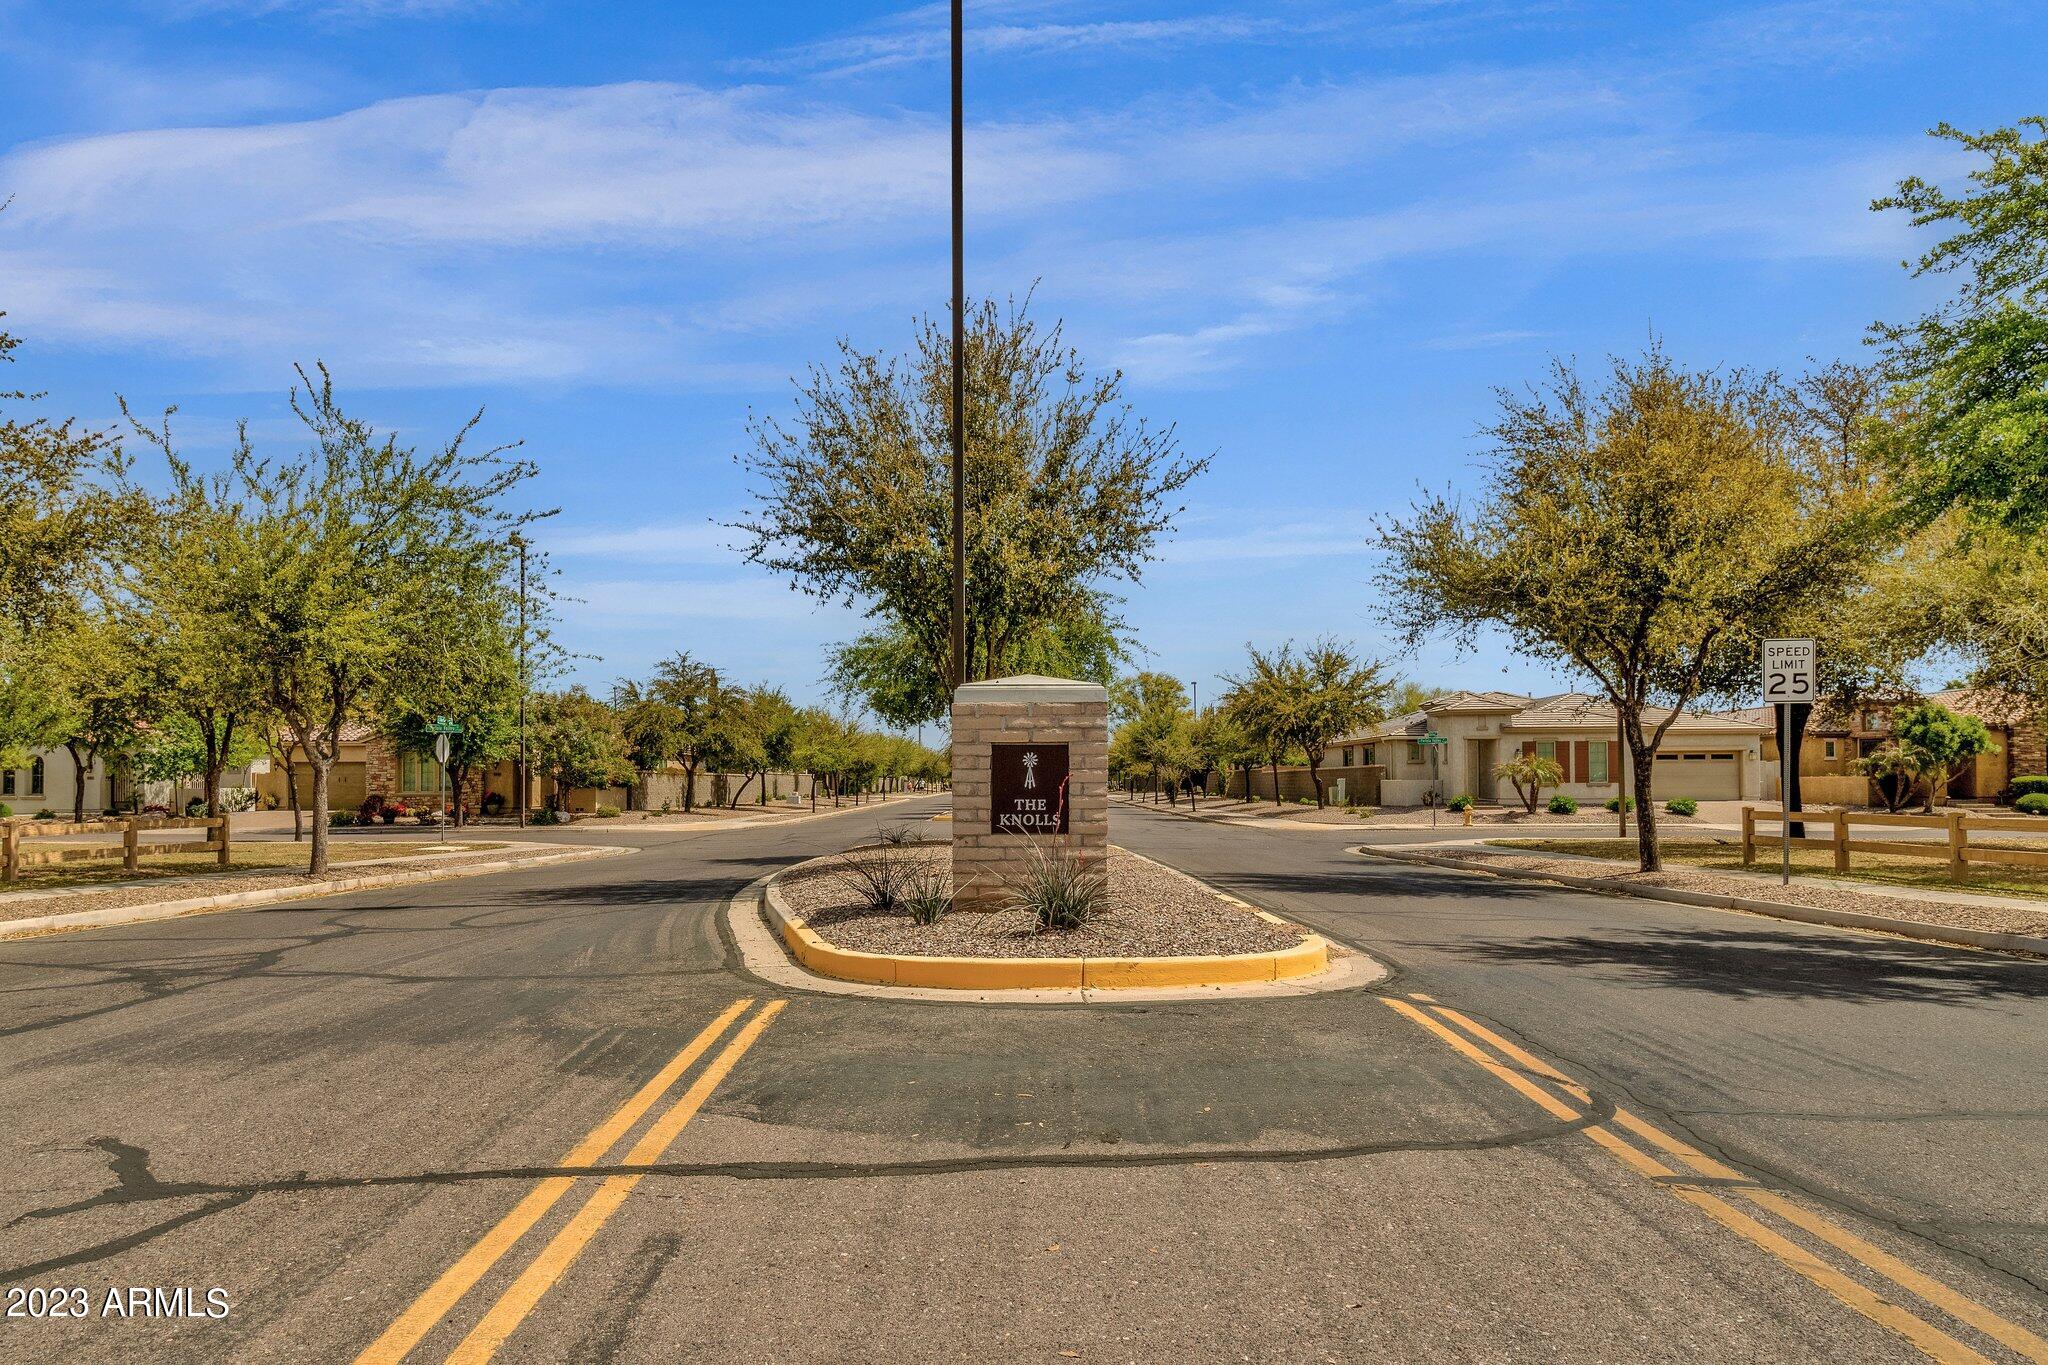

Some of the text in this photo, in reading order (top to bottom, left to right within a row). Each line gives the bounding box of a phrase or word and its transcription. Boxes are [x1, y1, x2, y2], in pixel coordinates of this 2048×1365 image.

[1768, 646, 1811, 657] SPEED
[1772, 660, 1805, 669] LIMIT
[1769, 673, 1809, 694] 25
[1014, 799, 1047, 811] THE
[999, 813, 1060, 826] KNOLLS
